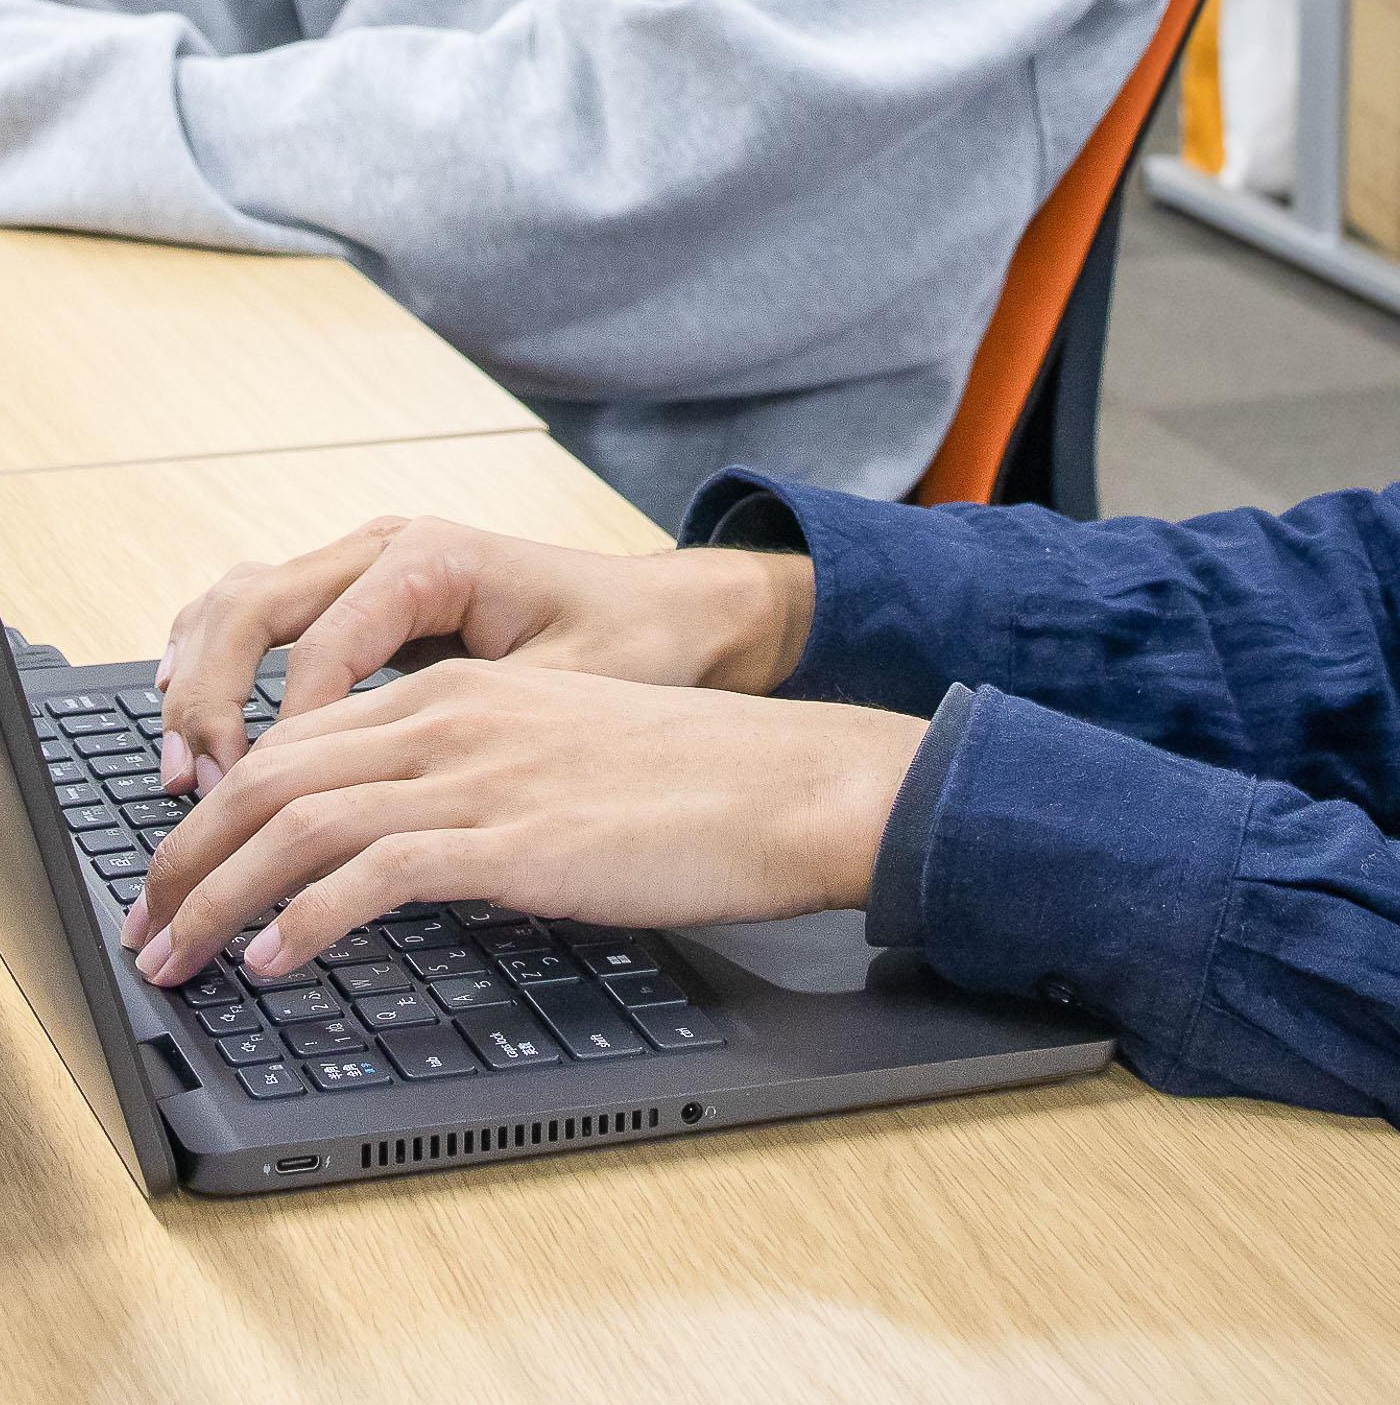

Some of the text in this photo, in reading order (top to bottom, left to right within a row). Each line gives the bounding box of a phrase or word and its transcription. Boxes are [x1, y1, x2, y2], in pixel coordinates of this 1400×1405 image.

[470, 913, 490, 922] C
[404, 934, 424, 944] D
[328, 950, 349, 959] E
[429, 963, 449, 973] S
[522, 970, 543, 979] Z
[349, 978, 373, 989] W
[396, 996, 417, 1008] た
[452, 993, 474, 1002] A
[231, 1004, 244, 1014] F2
[311, 1002, 329, 1011] 2
[376, 1010, 396, 1021] Q
[334, 1036, 351, 1044] 1
